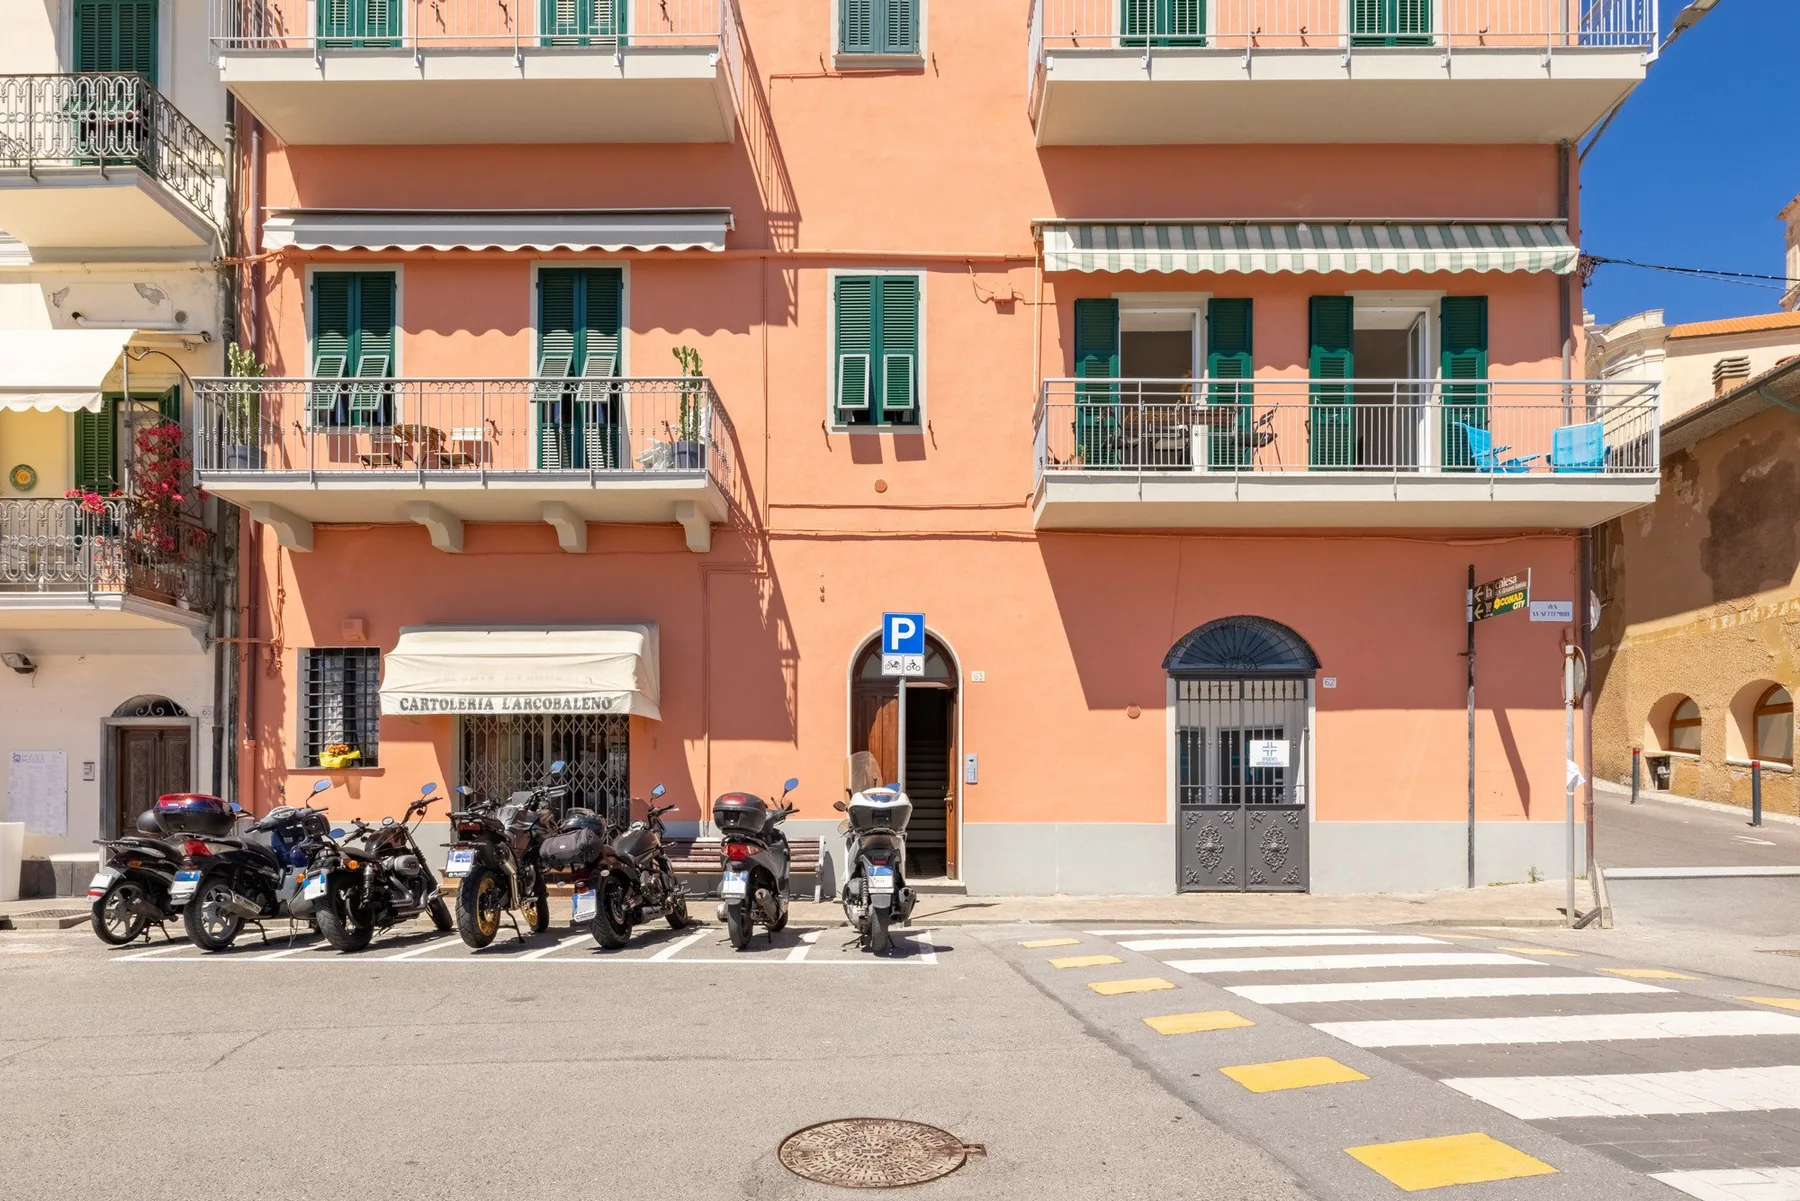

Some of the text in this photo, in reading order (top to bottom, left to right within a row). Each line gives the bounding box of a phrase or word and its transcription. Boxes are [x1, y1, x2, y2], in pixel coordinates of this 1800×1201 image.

[1500, 592, 1523, 605] CONAD
[1512, 600, 1525, 610] CITY
[891, 617, 916, 650] P
[400, 696, 613, 711] CARTOLERIA L'ARCOBALENO
